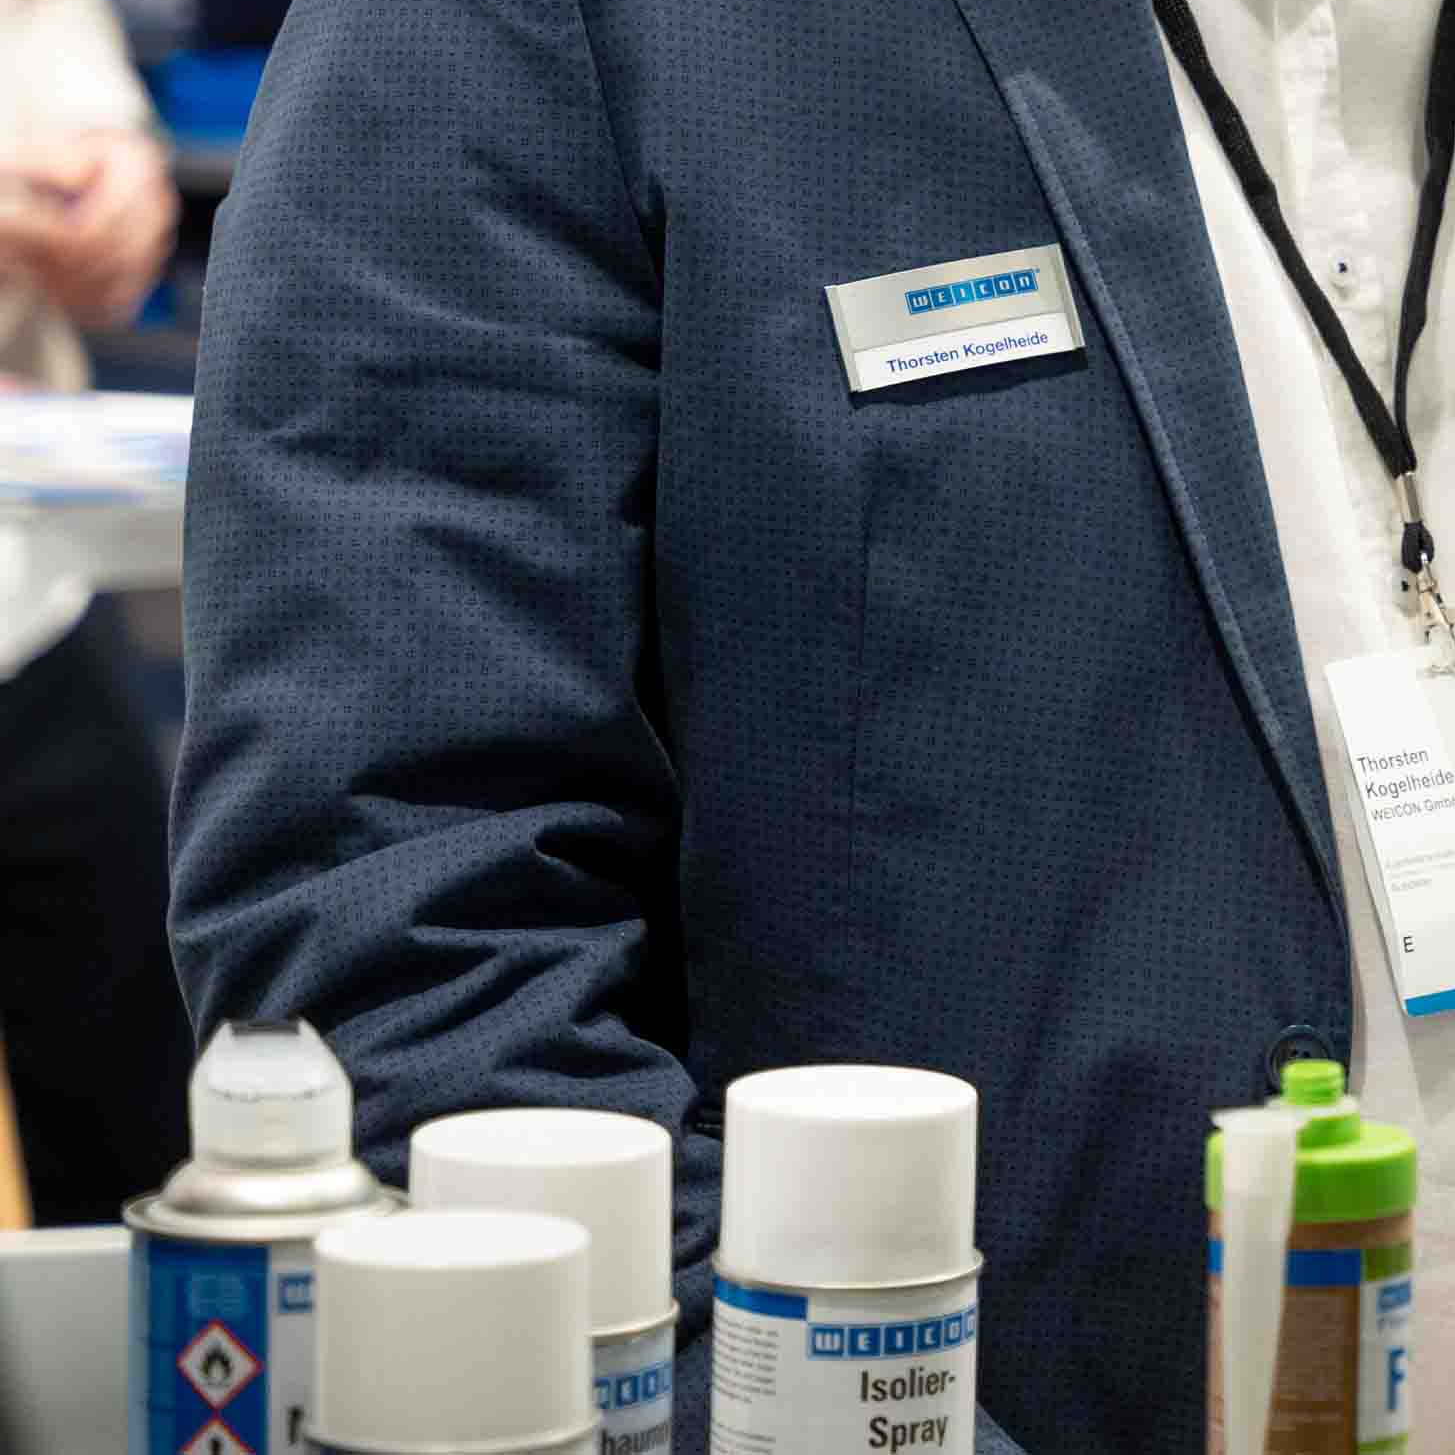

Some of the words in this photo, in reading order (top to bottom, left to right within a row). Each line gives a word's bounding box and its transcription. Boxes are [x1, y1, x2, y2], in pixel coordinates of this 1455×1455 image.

[886, 349, 960, 372] Thorsten
[963, 332, 1049, 357] Kogelheide
[1357, 748, 1430, 774] Thorsten
[1365, 769, 1455, 799] Kogelheide
[1371, 802, 1422, 822] WEICON
[1403, 936, 1415, 953] E
[862, 1366, 955, 1402] Isolier-
[869, 1416, 949, 1454] Spray
